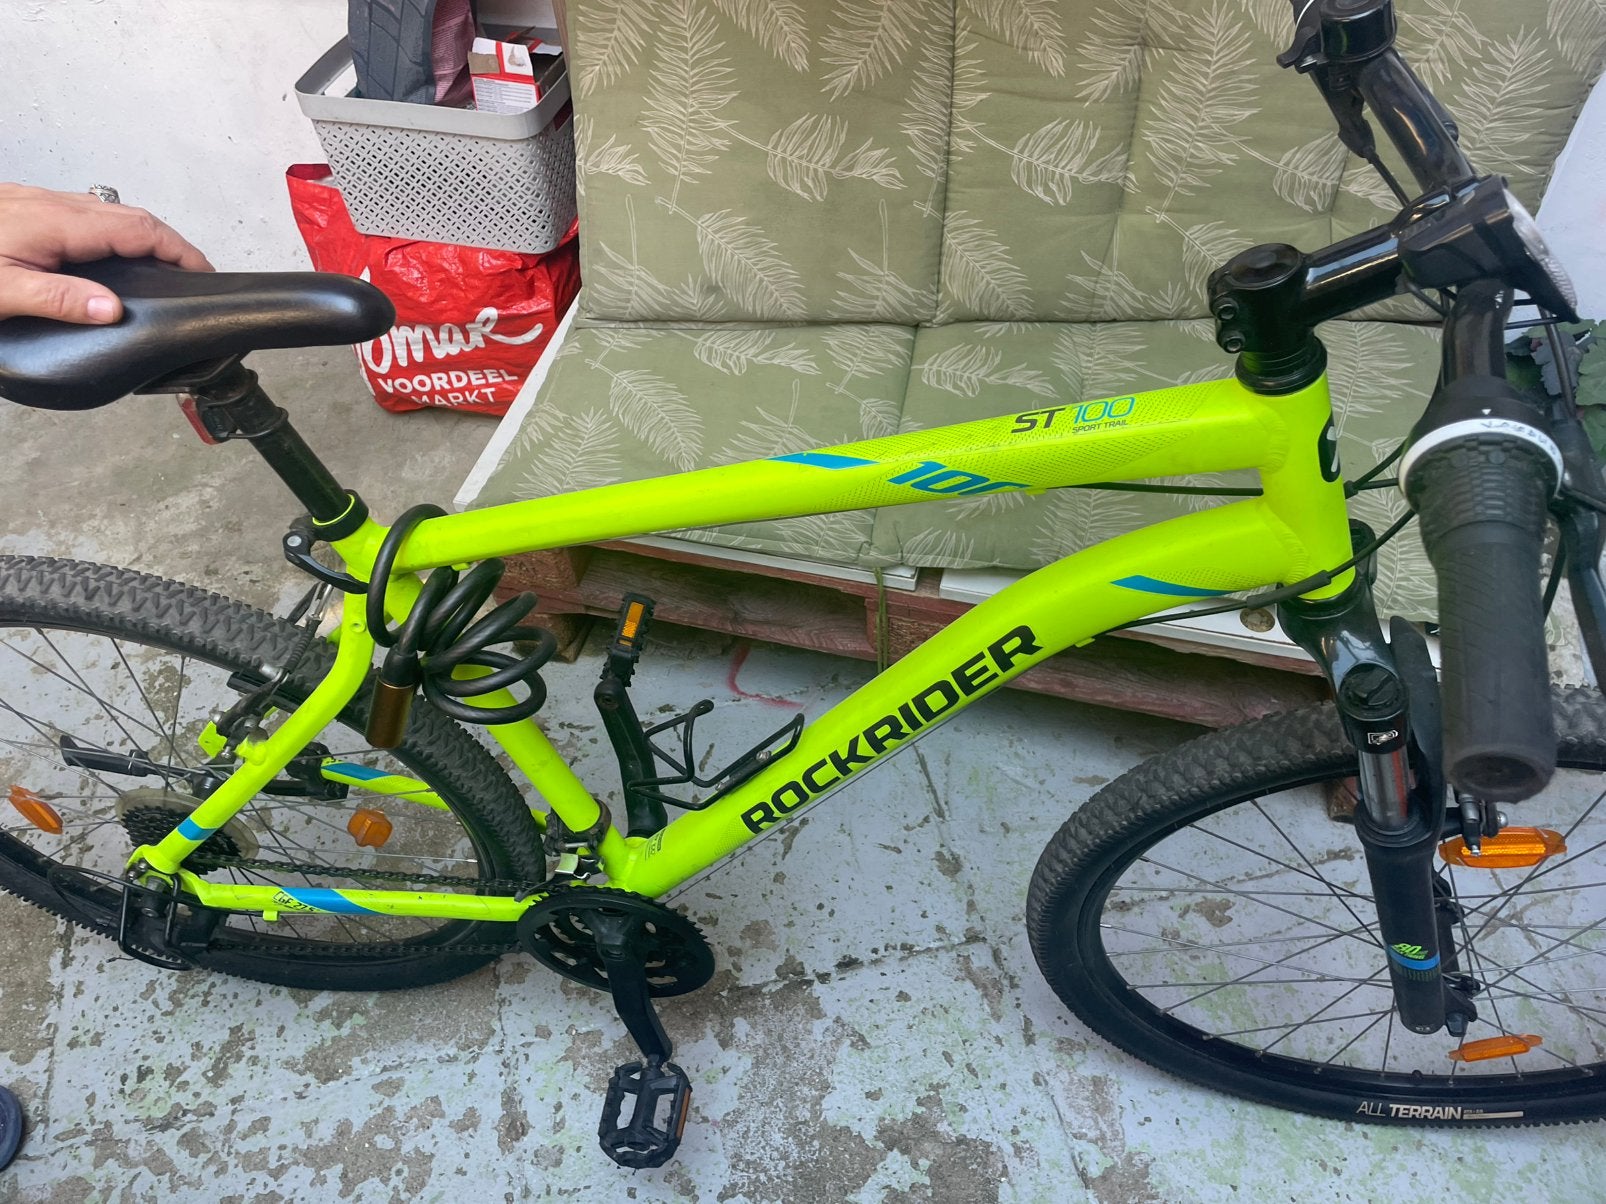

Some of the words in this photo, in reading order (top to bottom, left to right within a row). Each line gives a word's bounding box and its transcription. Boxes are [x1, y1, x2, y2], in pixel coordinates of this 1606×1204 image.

[377, 368, 518, 394] VOORDEEL
[1011, 407, 1066, 434] ST
[1073, 396, 1136, 424] 100
[1072, 422, 1102, 434] SPORT
[1104, 419, 1127, 429] TRAIL
[740, 624, 1044, 834] ROCKRIDER
[1356, 1101, 1386, 1117] ALL
[1389, 1103, 1461, 1120] TERRAIN
